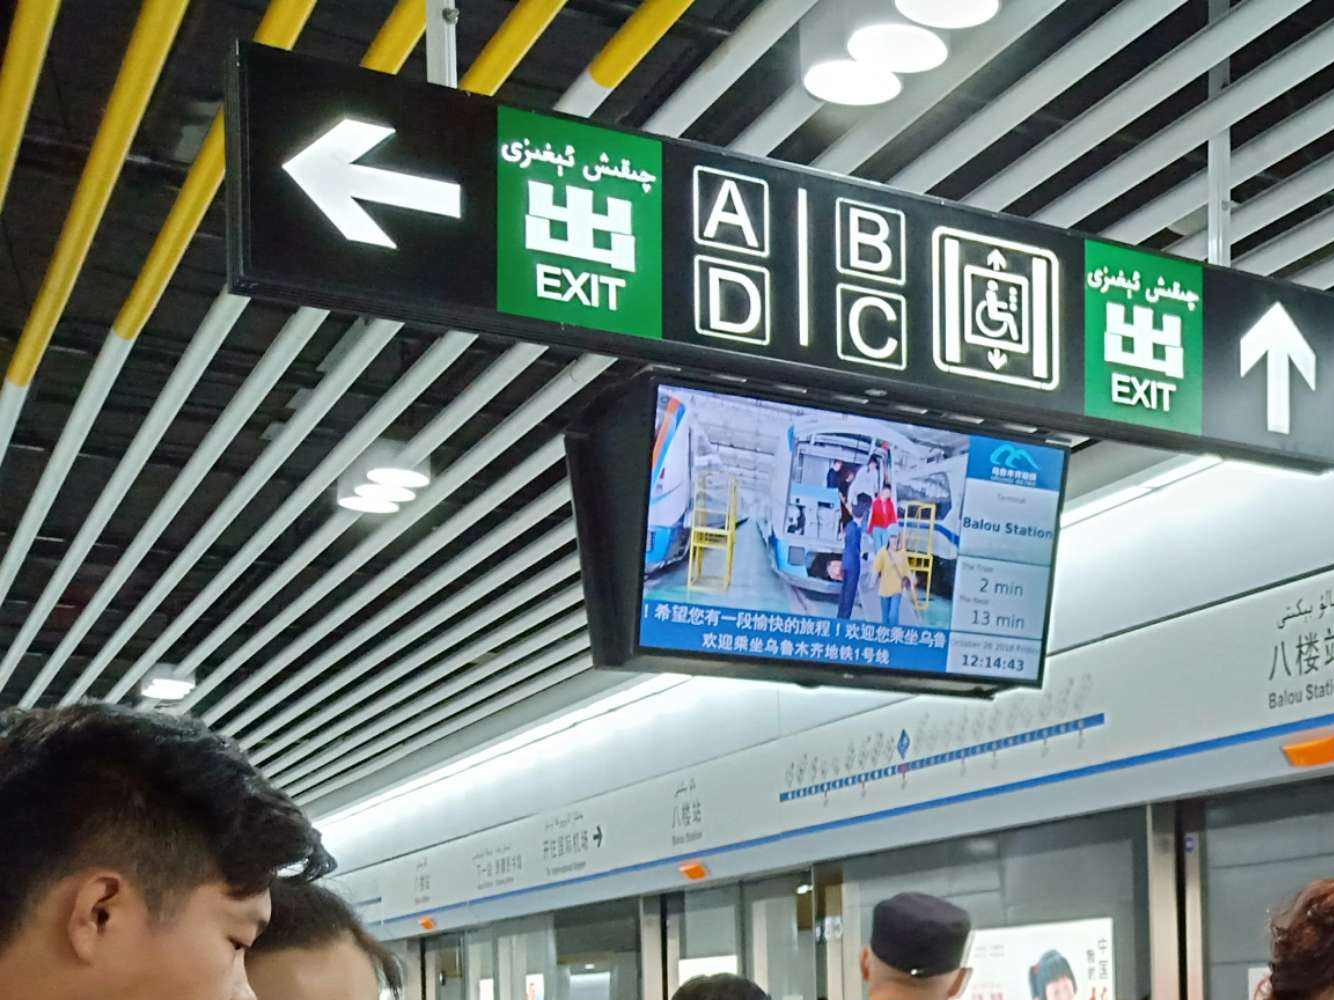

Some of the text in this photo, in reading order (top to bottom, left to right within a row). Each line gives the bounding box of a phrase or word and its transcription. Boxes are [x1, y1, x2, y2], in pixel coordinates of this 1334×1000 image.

[702, 179, 760, 248] A
[849, 207, 893, 273] B
[535, 262, 626, 312] EXIT
[708, 267, 763, 333] D
[848, 296, 898, 358] C
[1112, 372, 1176, 412] EXIT
[962, 516, 1054, 539] Balou Station
[979, 577, 1024, 597] 2 min
[971, 609, 1025, 630] 13 min
[961, 653, 1025, 672] 12:14:43
[1268, 689, 1303, 710] Balou
